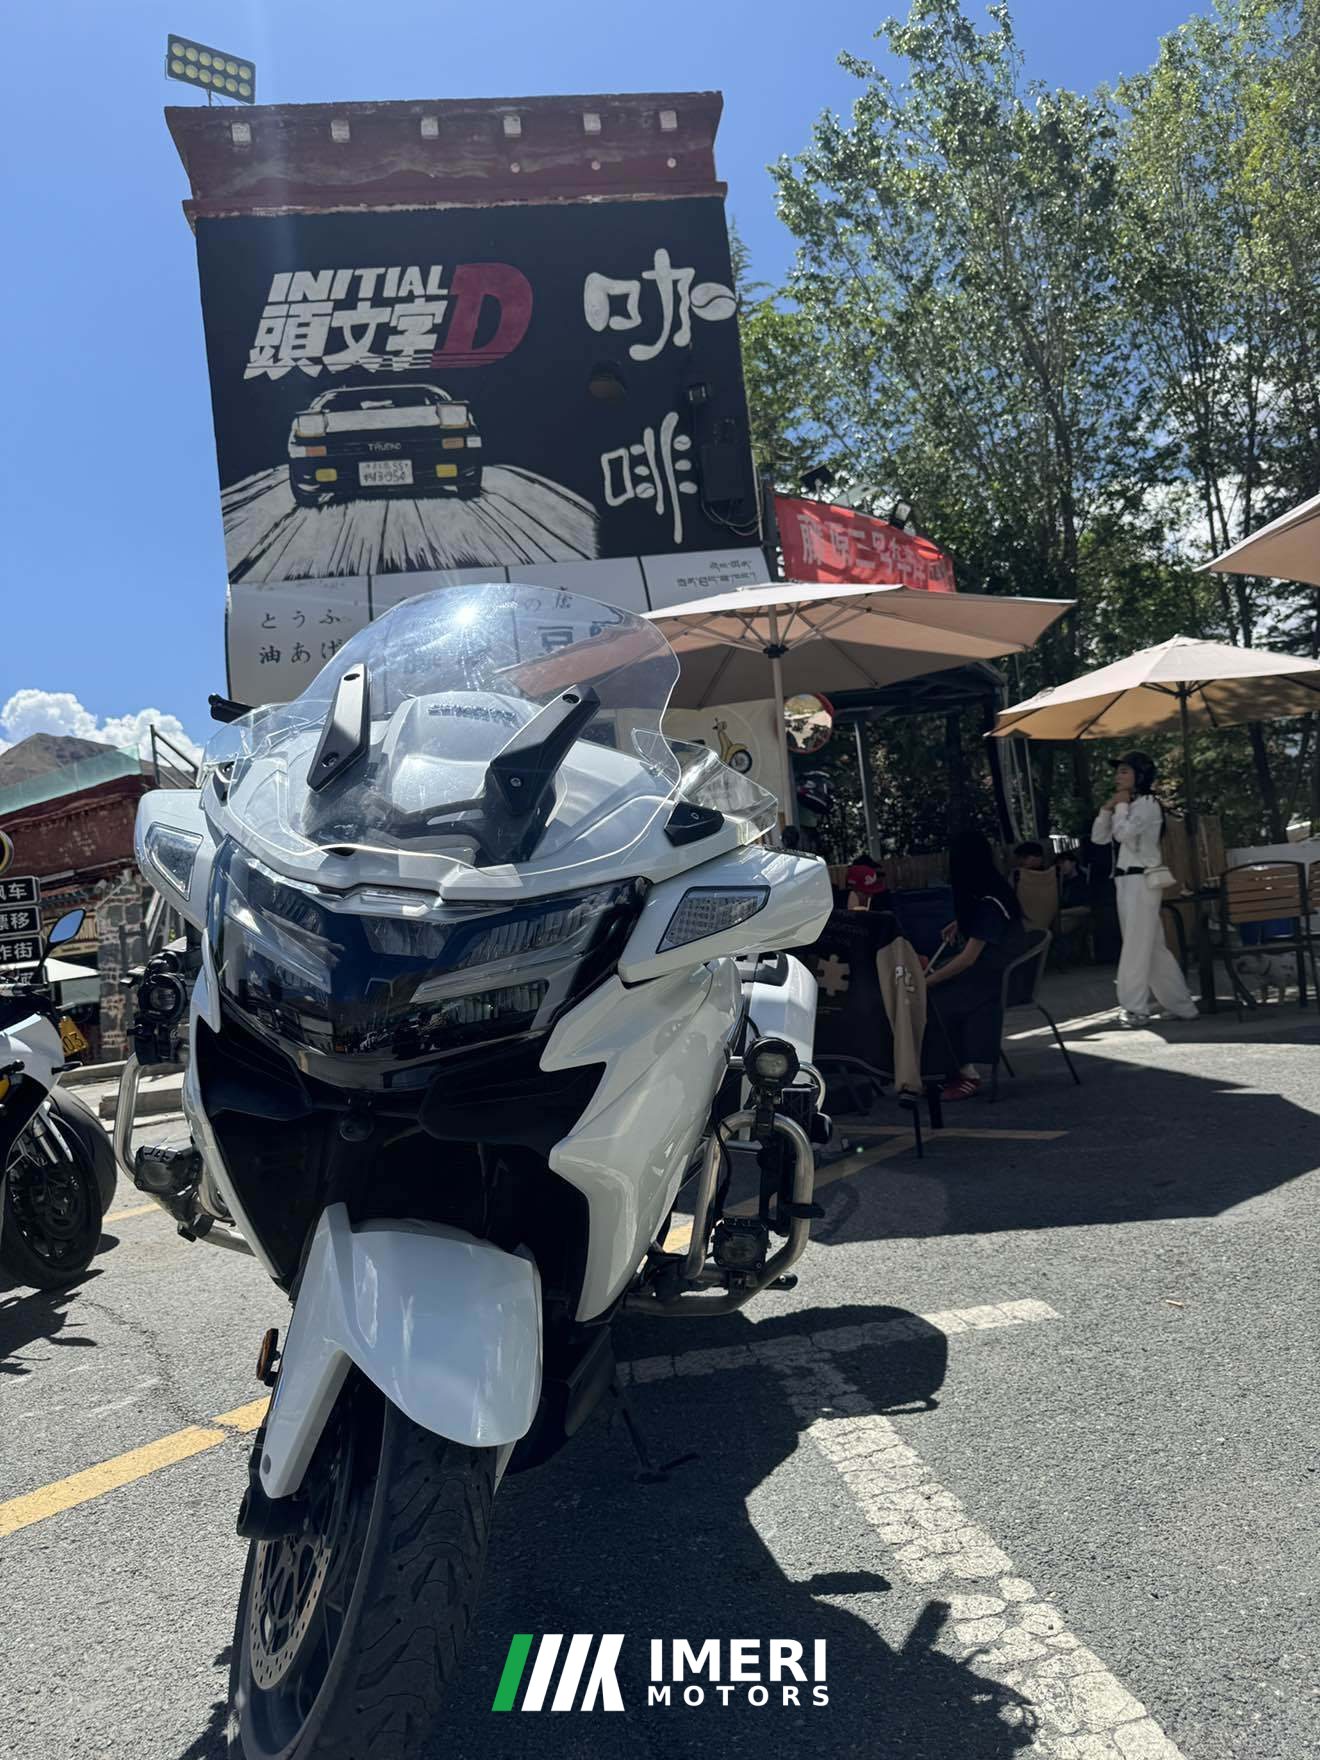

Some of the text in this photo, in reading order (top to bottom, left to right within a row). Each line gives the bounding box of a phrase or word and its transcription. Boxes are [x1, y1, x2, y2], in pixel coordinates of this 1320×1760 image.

[243, 297, 448, 381] 頭文字
[267, 262, 534, 369] INITIAL D
